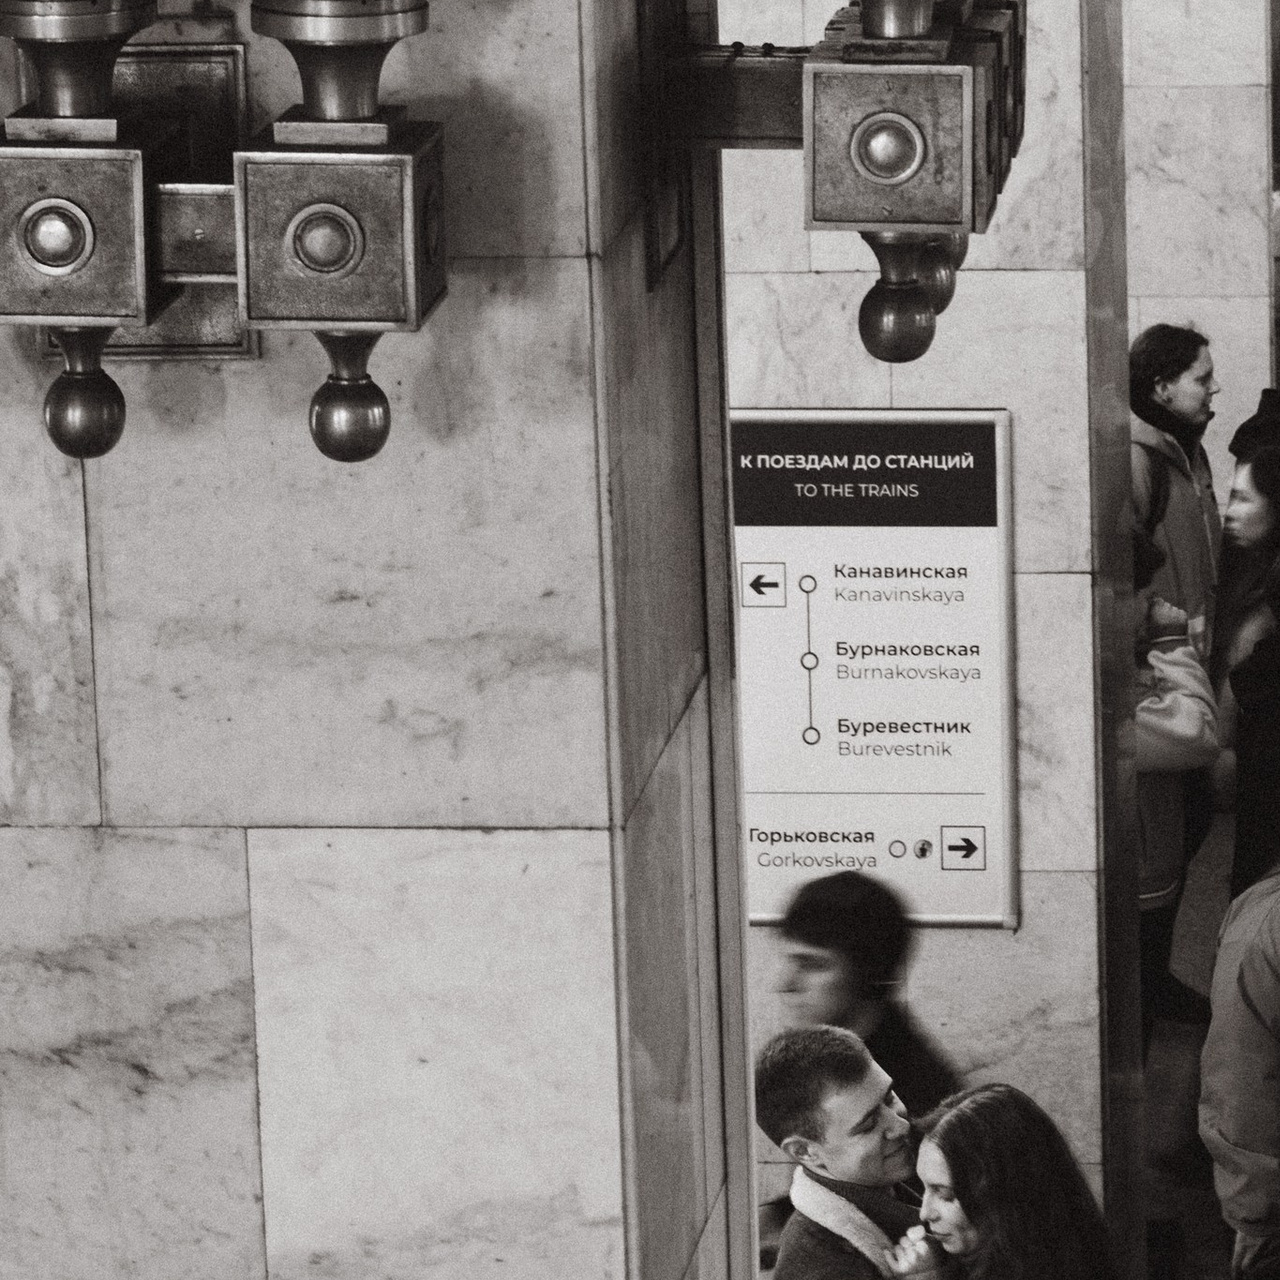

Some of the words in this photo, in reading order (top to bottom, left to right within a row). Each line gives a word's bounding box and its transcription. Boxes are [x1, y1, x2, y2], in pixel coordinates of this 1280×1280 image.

[740, 454, 753, 469] К
[757, 454, 849, 471] ПОЕЗДАМ
[853, 454, 881, 471] ДО
[885, 451, 975, 471] СТАНЦИЙ
[794, 483, 818, 498] TO
[821, 483, 854, 498] THE
[858, 483, 920, 498] TRAINS
[834, 563, 969, 579] Канавинская
[834, 586, 966, 606] Kanavinskaya
[835, 641, 981, 660] Бурнаковская
[836, 663, 982, 683] Burnakovskaya
[837, 718, 972, 737] Буревестник
[838, 740, 953, 757] Burevestnik
[749, 828, 875, 846] Горьковская
[757, 852, 878, 871] Gorkovskaya
